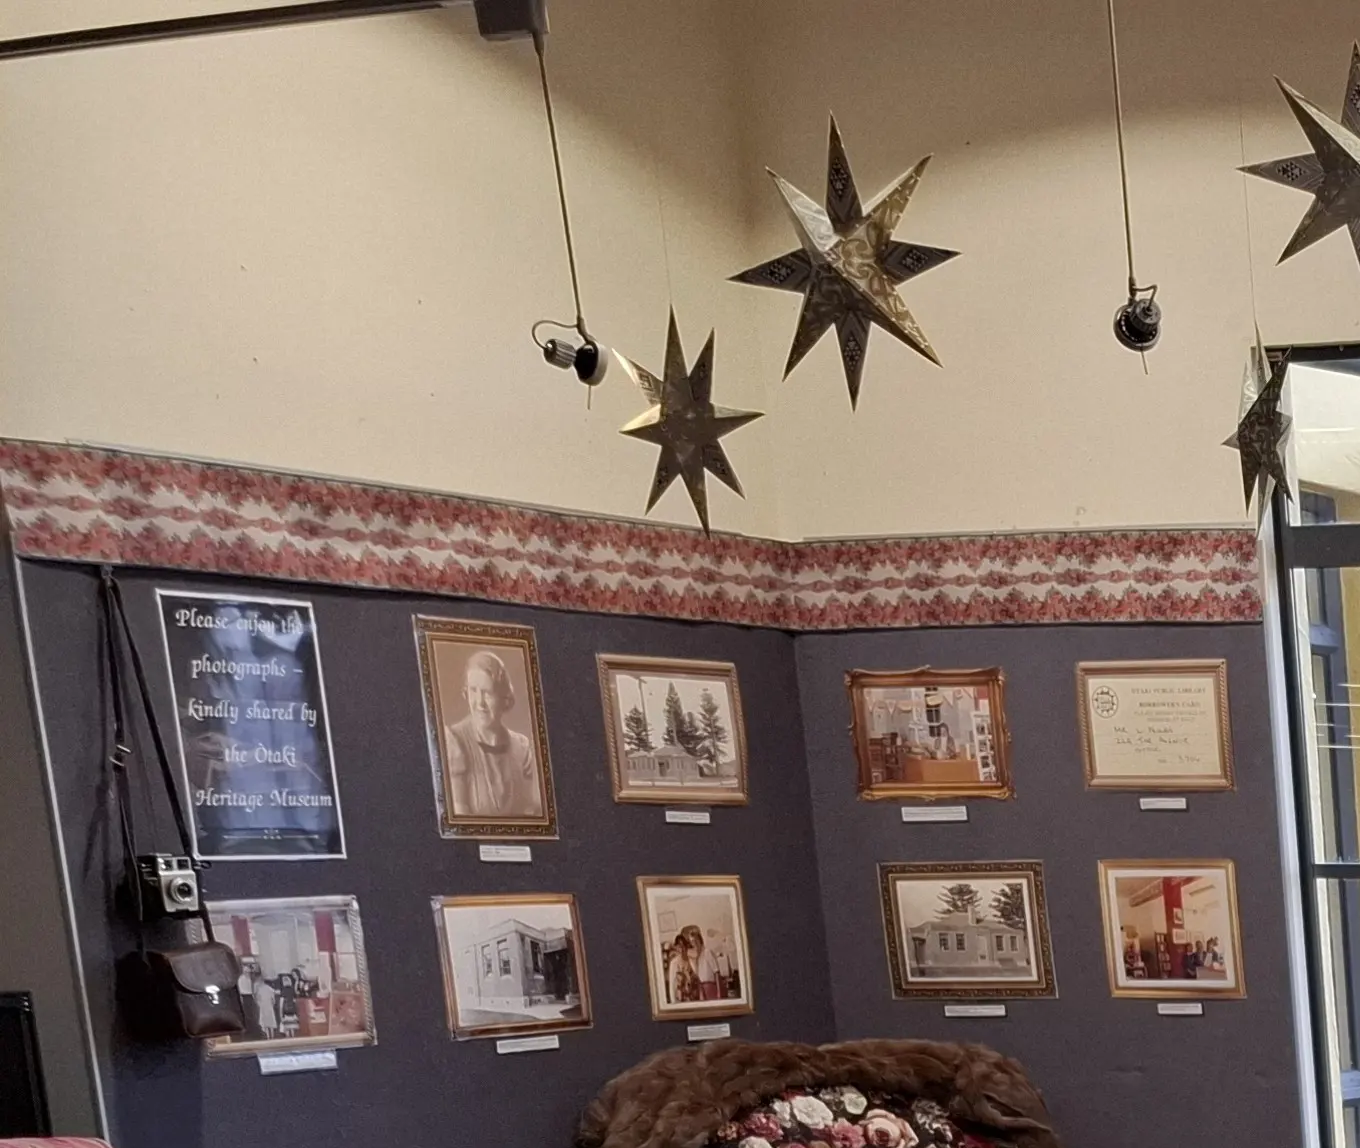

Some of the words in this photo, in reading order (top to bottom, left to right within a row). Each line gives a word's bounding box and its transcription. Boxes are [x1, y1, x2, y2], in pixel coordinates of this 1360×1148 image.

[175, 608, 229, 629] Please
[236, 614, 276, 637] enjoy
[191, 654, 287, 682] photographs
[188, 698, 239, 724] kindly
[246, 700, 294, 721] shared
[301, 702, 318, 727] by
[224, 744, 247, 764] the
[195, 787, 263, 812] Heritage
[270, 790, 333, 807] Museum
